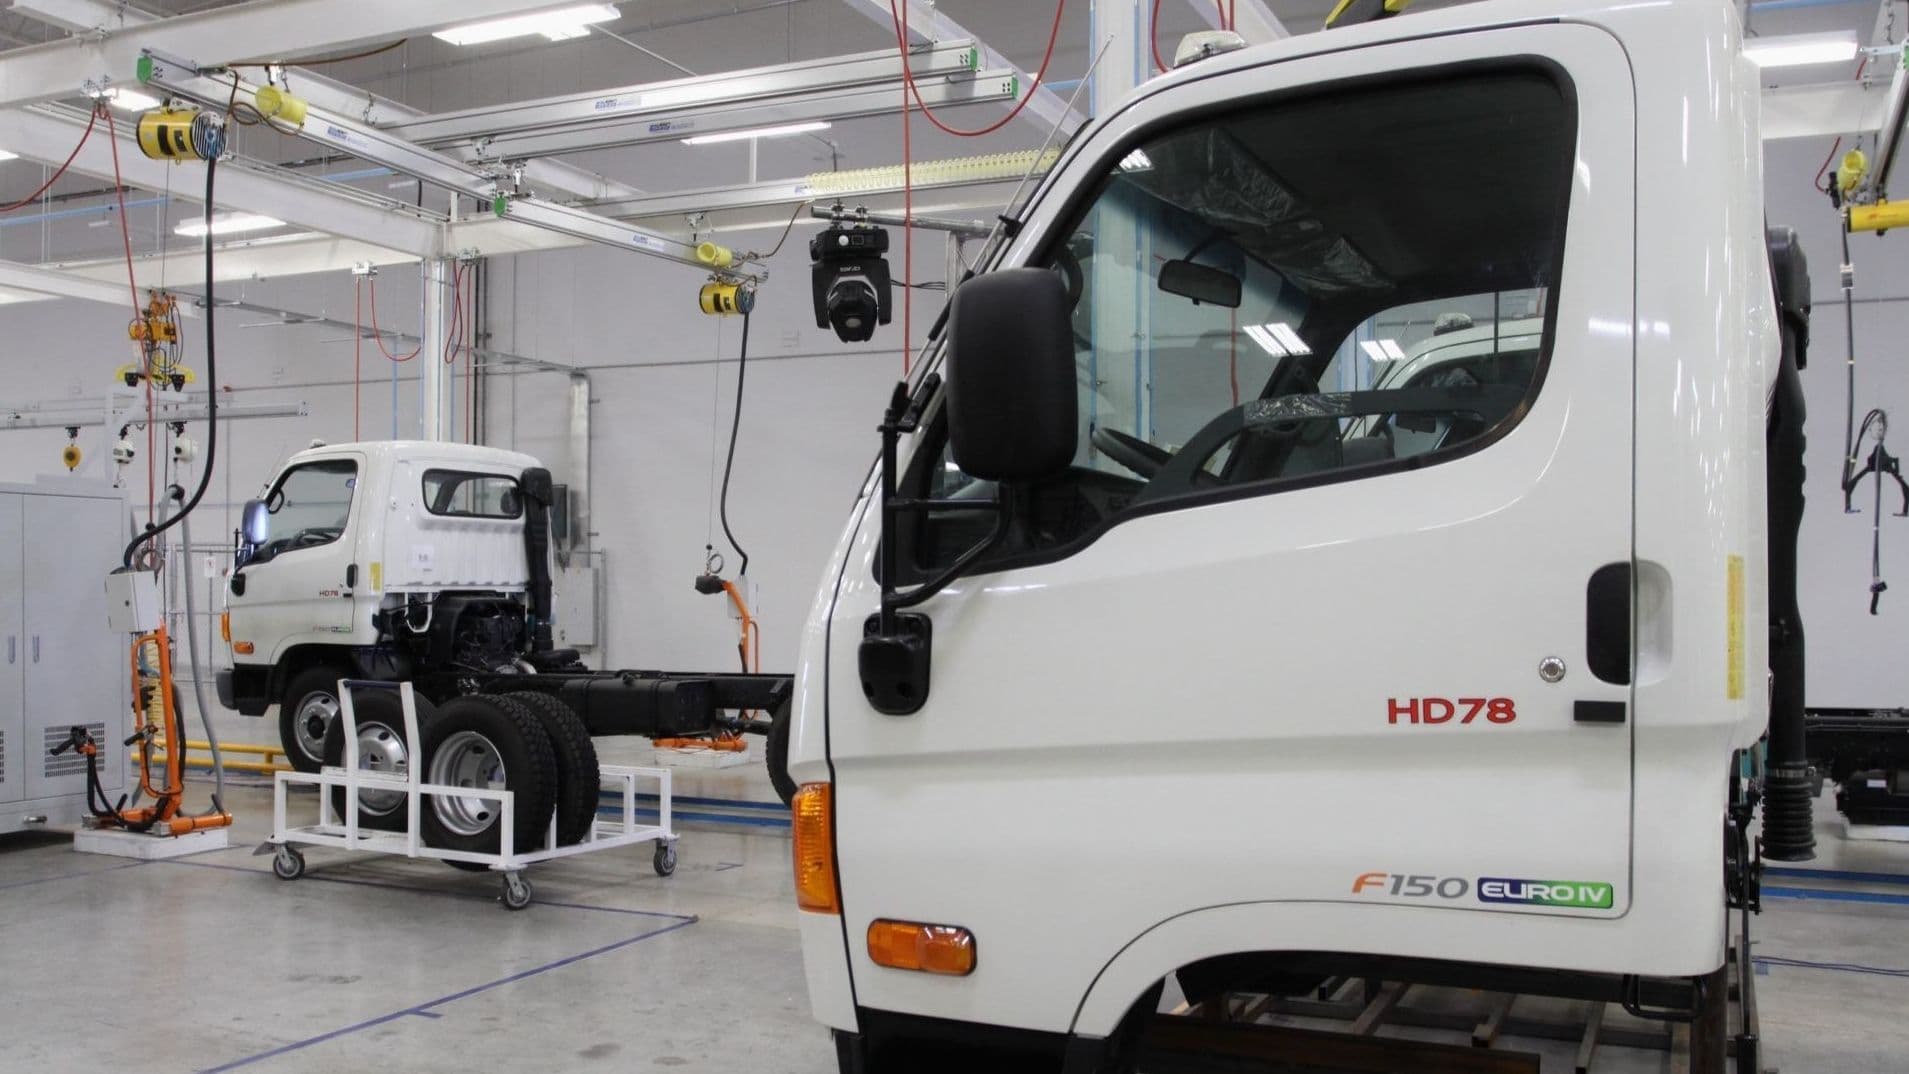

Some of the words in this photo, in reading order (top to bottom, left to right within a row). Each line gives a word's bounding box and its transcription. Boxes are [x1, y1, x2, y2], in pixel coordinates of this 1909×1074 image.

[1387, 697, 1517, 724] HD78
[1351, 872, 1470, 899] F150
[1480, 881, 1575, 901] EURO
[1578, 886, 1607, 903] IV
